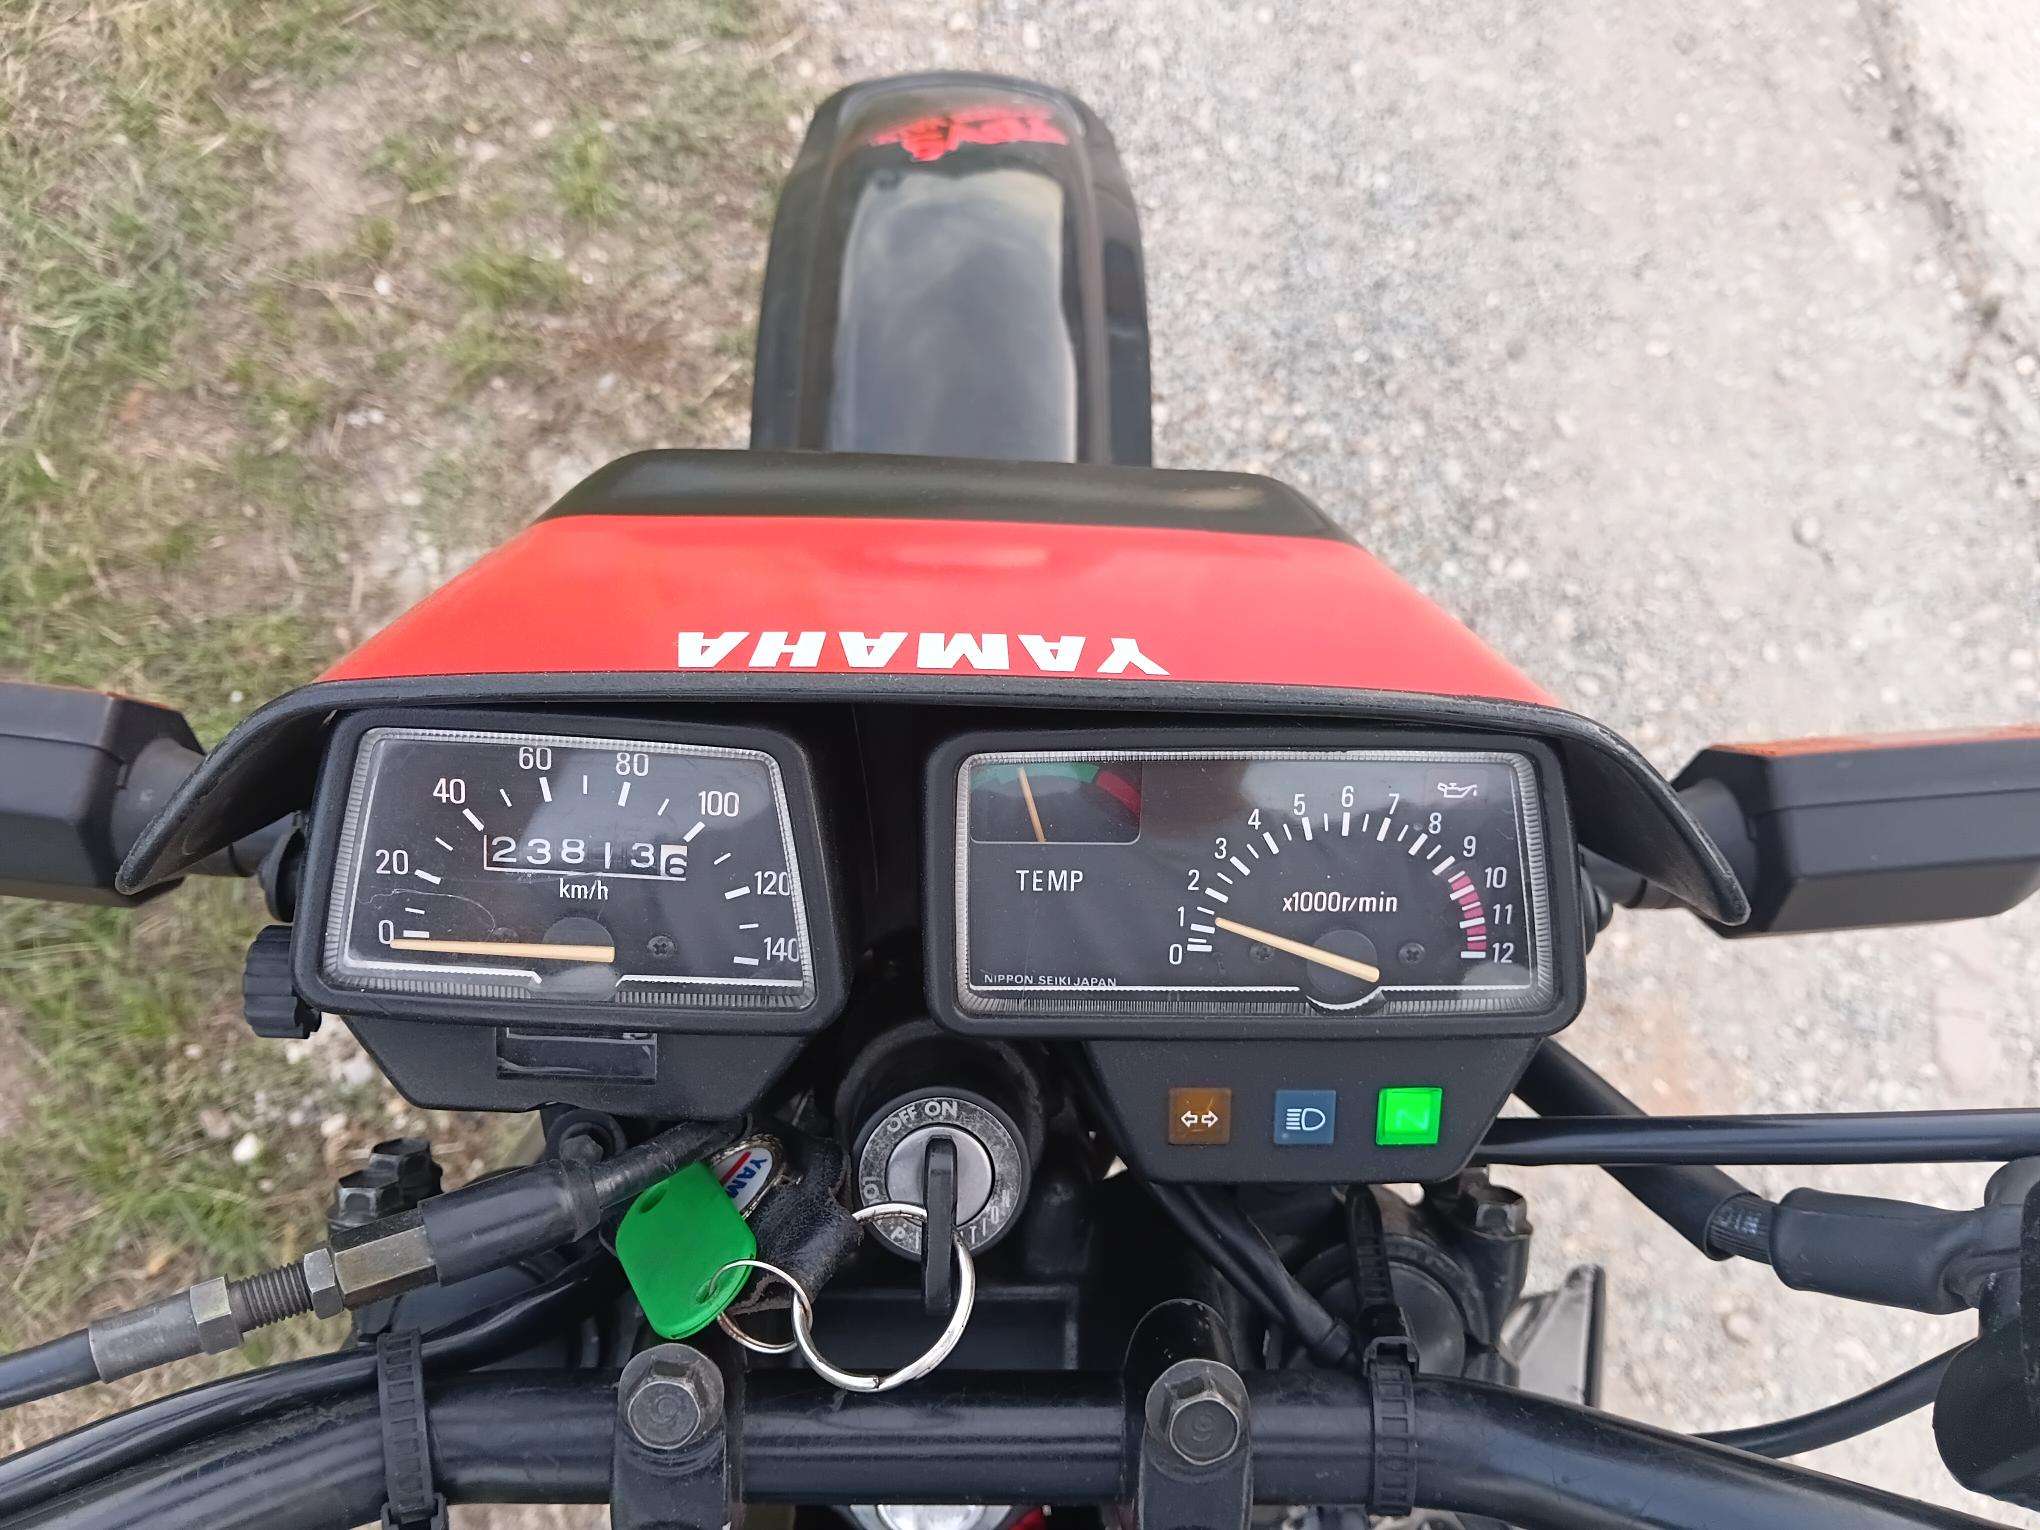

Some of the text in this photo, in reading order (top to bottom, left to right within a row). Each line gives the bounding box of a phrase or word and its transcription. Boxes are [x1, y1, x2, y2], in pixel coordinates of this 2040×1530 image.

[678, 631, 1170, 676] YAMAHA
[519, 747, 552, 770] 60
[616, 752, 648, 776] 80
[433, 778, 465, 804] 40
[1342, 786, 1354, 807] 6
[699, 791, 739, 817] 100
[1293, 795, 1306, 816] 5
[1388, 794, 1400, 815] 7
[1248, 809, 1261, 830] 4
[1429, 812, 1441, 834] 8
[1215, 838, 1226, 859] 3
[1463, 836, 1476, 857] 9
[376, 850, 408, 874] 20
[754, 871, 790, 896] 120
[1016, 870, 1083, 891] TEMP
[1188, 870, 1199, 890] 2
[1485, 867, 1507, 888] 10
[559, 878, 608, 900] km/h
[1282, 891, 1398, 915] x1000r/min
[1178, 906, 1184, 926] 1
[1493, 904, 1512, 924] 11
[379, 920, 394, 944] 0
[764, 937, 799, 962] 140
[1169, 944, 1182, 964] 0
[1493, 943, 1513, 964] 12
[984, 974, 1116, 987] NIPPON SEIKI JAPAN
[887, 1105, 917, 1131] OFF
[924, 1101, 958, 1118] ON
[725, 1158, 768, 1199] YAM
